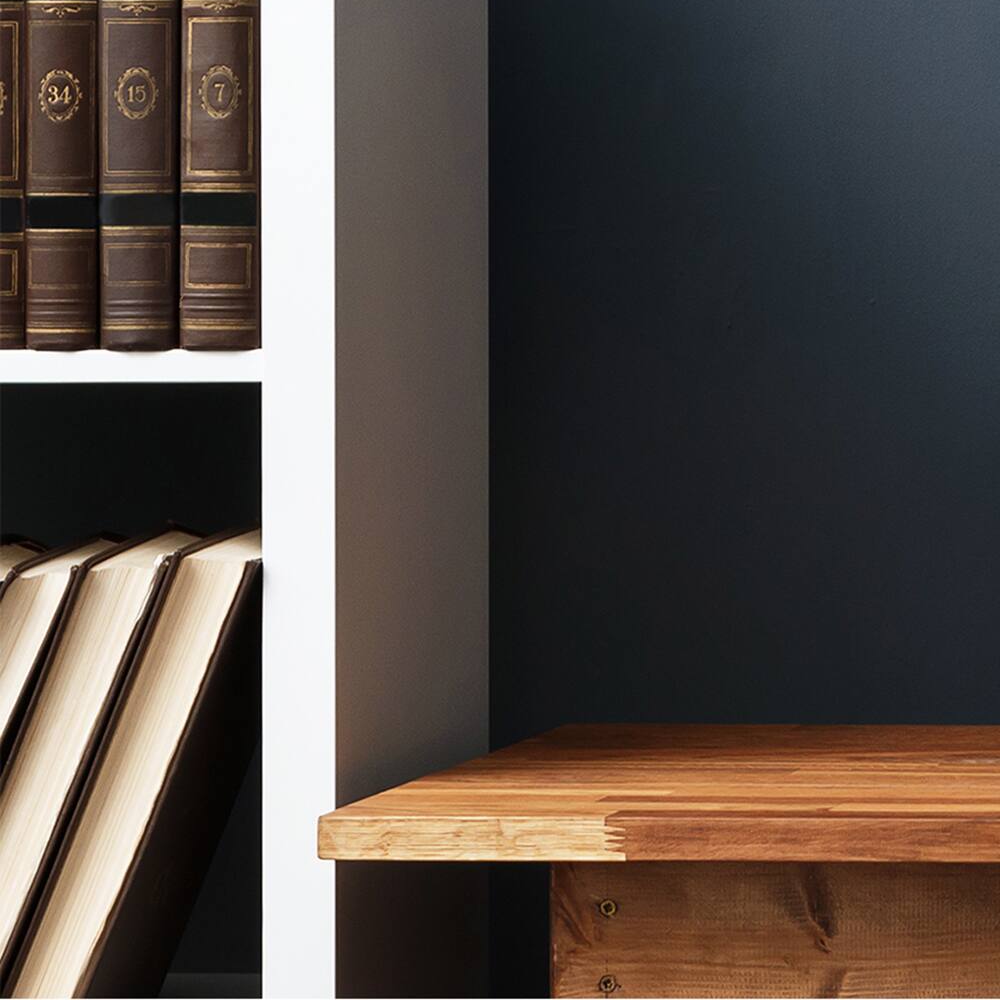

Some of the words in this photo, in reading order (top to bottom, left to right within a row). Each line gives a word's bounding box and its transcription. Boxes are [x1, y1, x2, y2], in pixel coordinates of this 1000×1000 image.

[48, 85, 72, 104] 34
[127, 85, 146, 102] 15
[214, 83, 226, 102] 7
